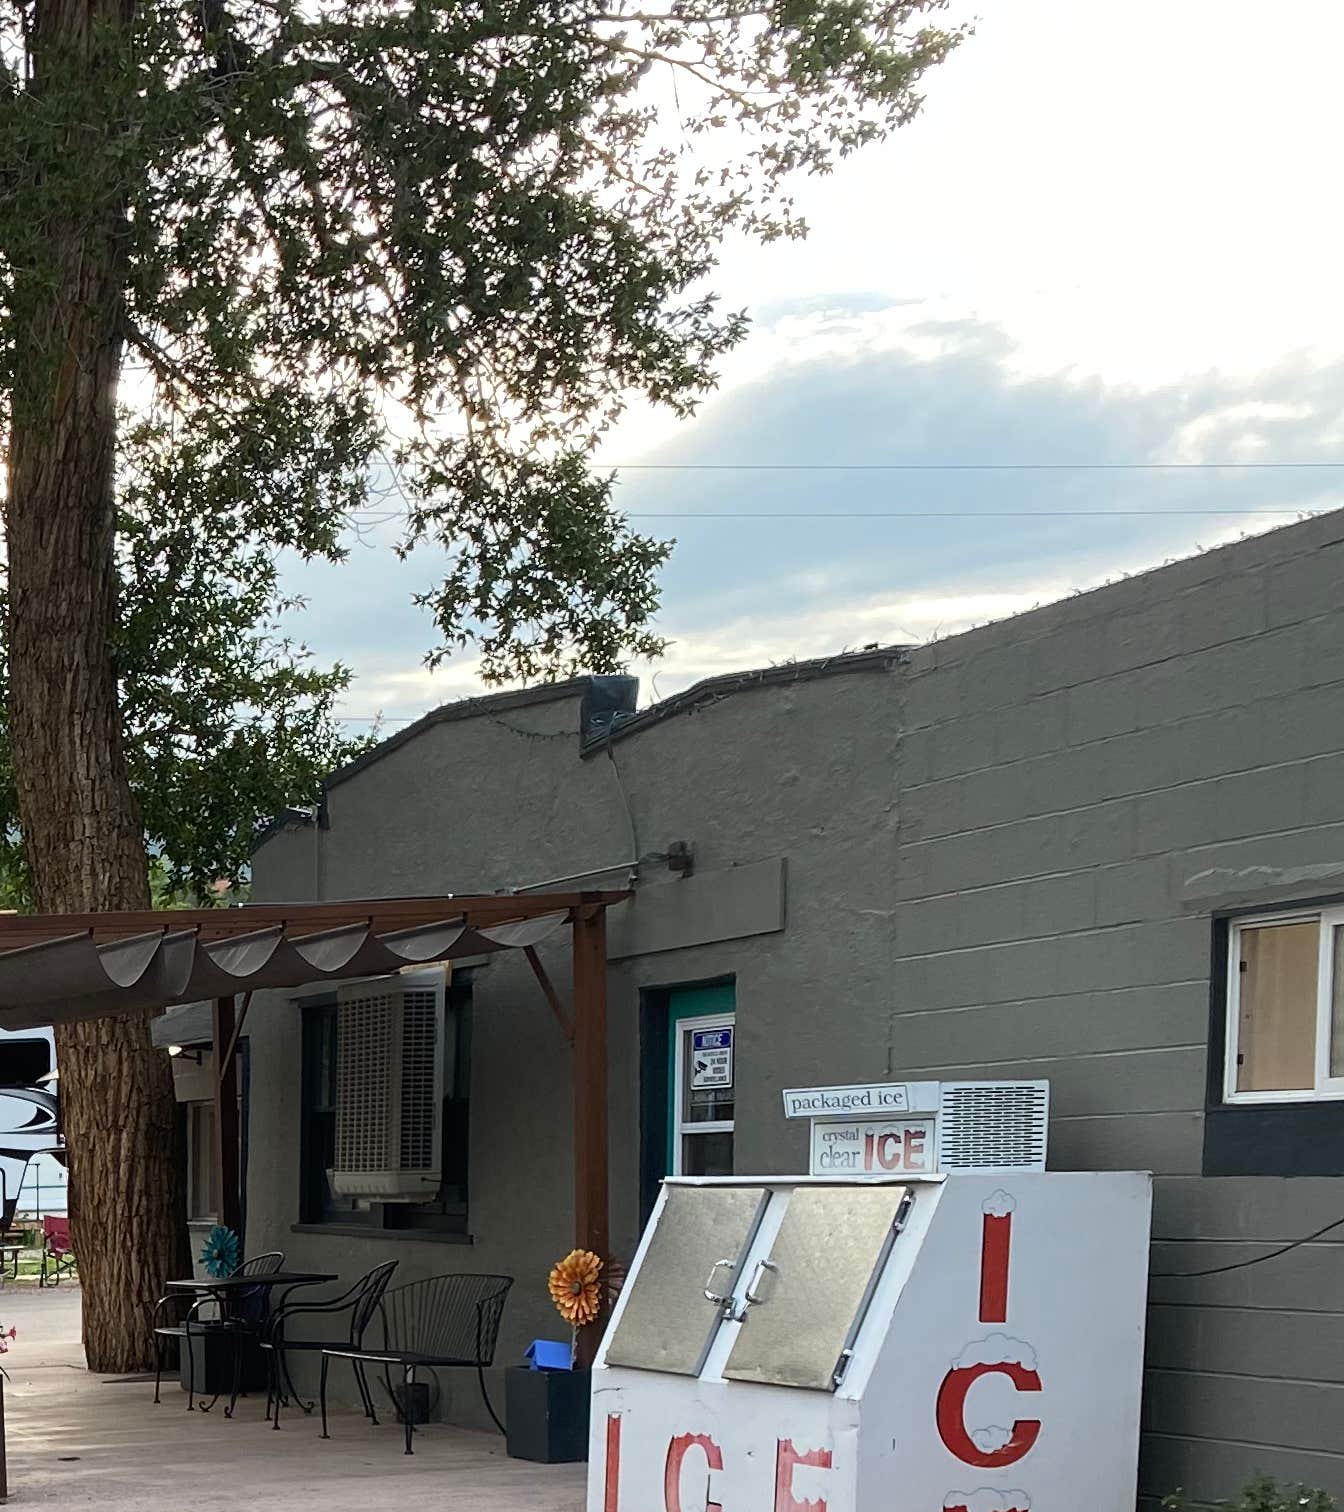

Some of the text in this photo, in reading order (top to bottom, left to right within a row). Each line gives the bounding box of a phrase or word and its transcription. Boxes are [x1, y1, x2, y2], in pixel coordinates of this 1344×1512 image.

[792, 1091, 904, 1113] packaged ice
[822, 1127, 860, 1144] crystal
[819, 1145, 861, 1169] clear
[864, 1127, 927, 1170] ICE
